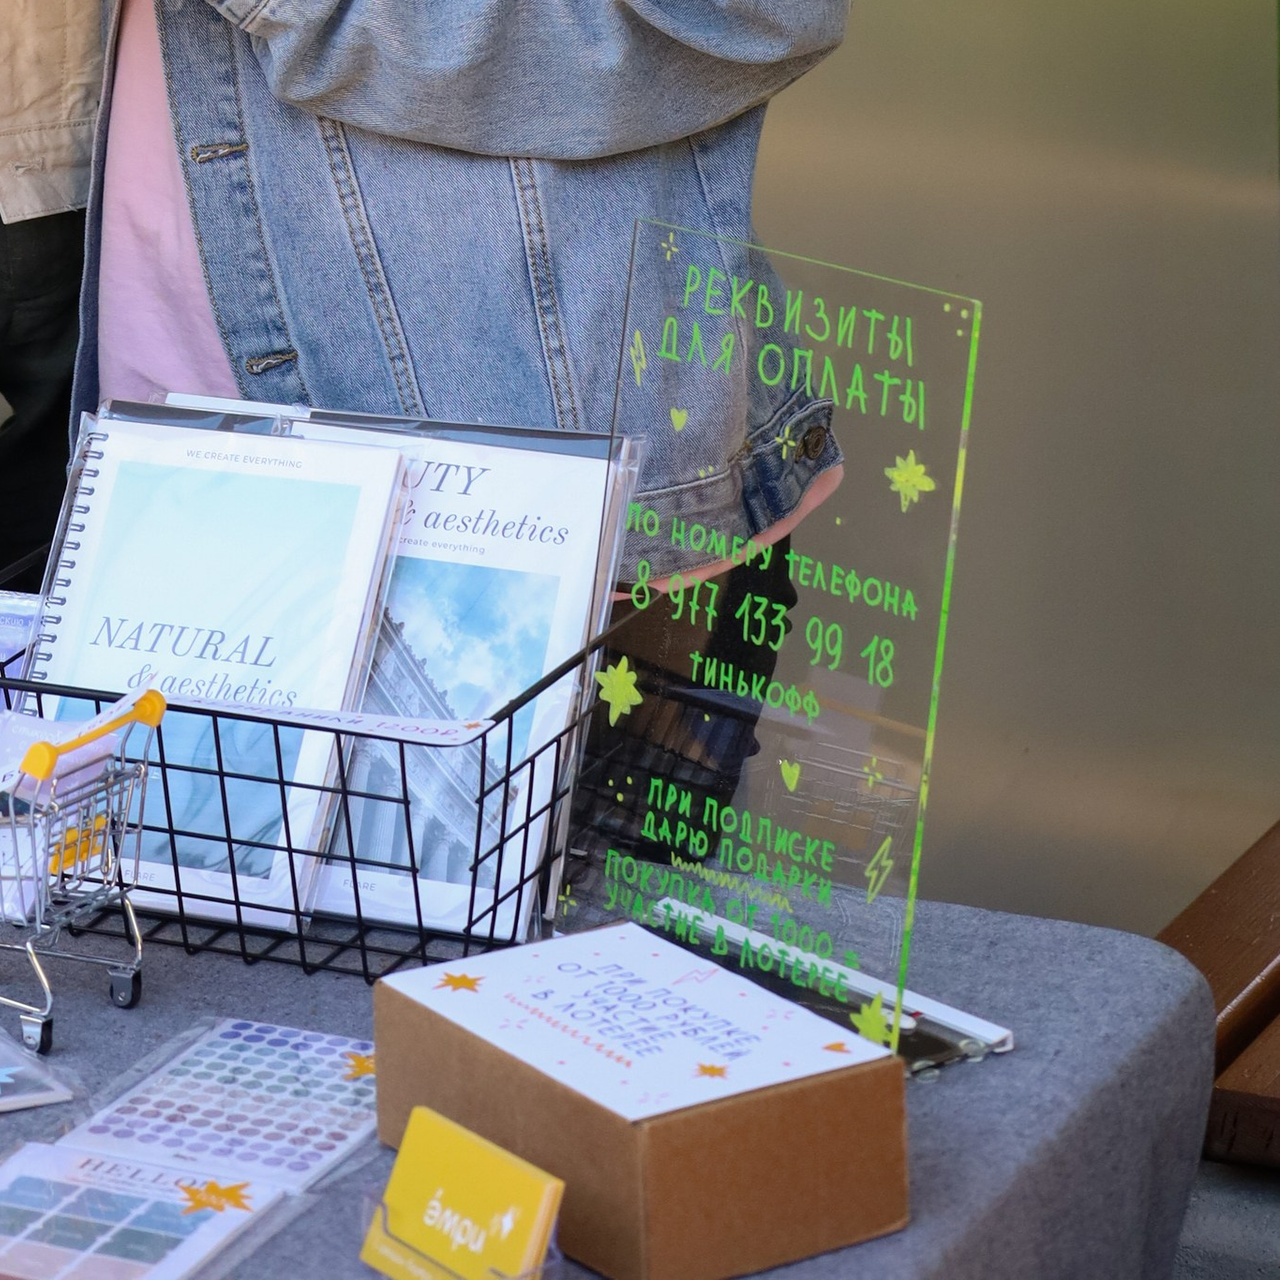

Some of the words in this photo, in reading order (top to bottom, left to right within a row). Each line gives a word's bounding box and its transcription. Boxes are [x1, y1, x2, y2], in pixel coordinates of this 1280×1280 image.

[684, 265, 913, 367] РЕКВИЗИТЫ
[657, 316, 736, 375] ДЛЯ
[757, 342, 925, 431] ОПЛАТЫ
[186, 449, 201, 459] WE
[204, 451, 240, 463] CREATE
[242, 455, 303, 469] EVERYTHING
[423, 508, 569, 546] aesthetics
[431, 539, 486, 555] everything
[626, 502, 659, 537] ПО
[672, 517, 773, 570] НОМЕРУ
[785, 548, 919, 621] ТЕЛЕФОНА
[89, 616, 278, 669] NATURAL
[631, 559, 651, 610] 8
[668, 573, 719, 632] 977
[735, 592, 788, 651] 133
[805, 616, 842, 671] 99
[860, 635, 894, 688] 18
[159, 672, 297, 709] aesthetics
[689, 650, 820, 725] ТИНЬКОФФ
[641, 811, 709, 857] ДАРЮ
[719, 838, 832, 909] ПОДАРКИ
[647, 777, 692, 818] ПРИ
[702, 796, 836, 872] ПОДПИСКЕ
[603, 882, 706, 945] УЧАСТИЕ
[740, 938, 849, 1003] ЛОТЕРЕЕ
[604, 849, 716, 917] ПОКУПКА
[726, 899, 760, 932] ОТ
[771, 913, 833, 959] 1000
[557, 961, 599, 980] ОТ
[595, 979, 657, 1012] 1000
[571, 989, 677, 1042] УЧАСТИЕ
[596, 962, 648, 986] ПРИ
[645, 987, 762, 1045] ПОКУПКЕ
[553, 1000, 663, 1059] ЛОТЕРЕЕ
